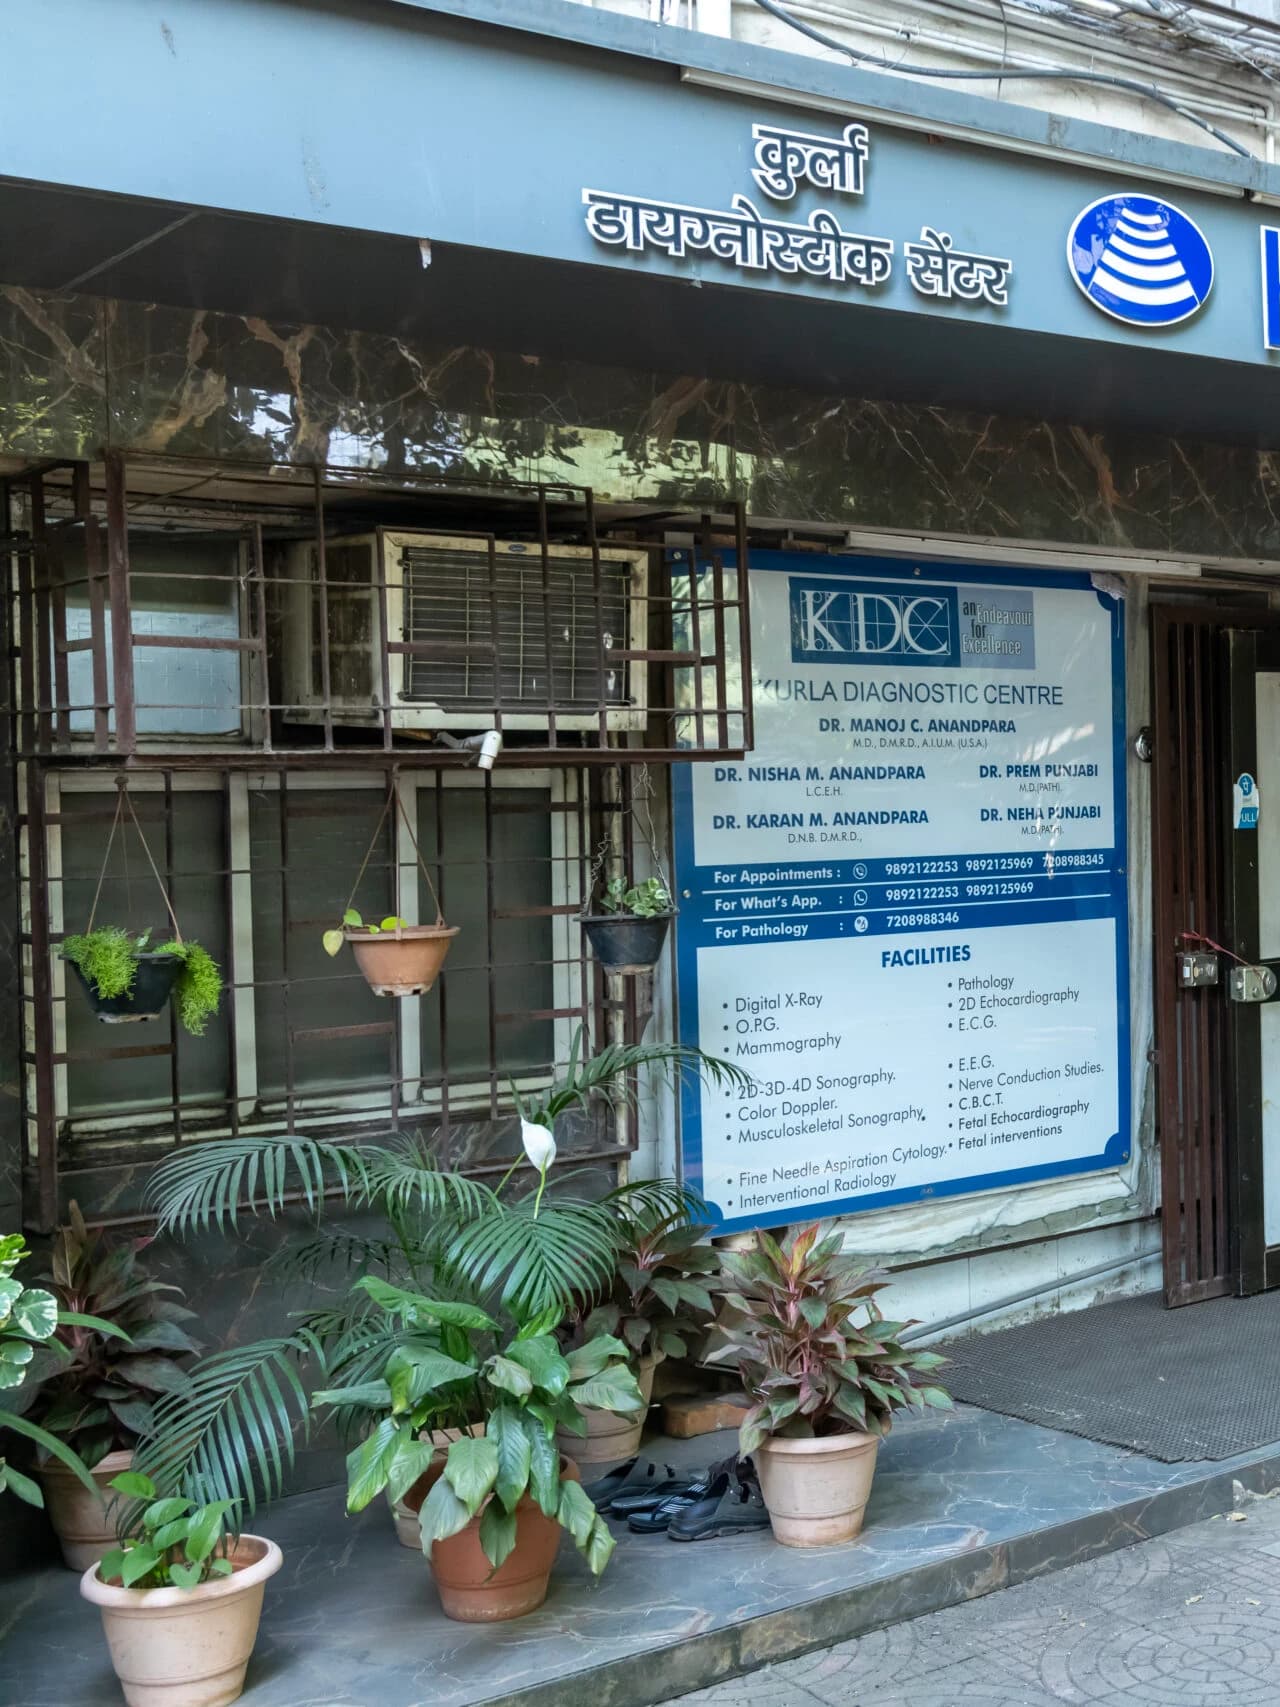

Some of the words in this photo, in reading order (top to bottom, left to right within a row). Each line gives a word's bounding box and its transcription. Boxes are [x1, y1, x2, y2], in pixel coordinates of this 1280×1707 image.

[752, 123, 868, 200] कुर्ला
[581, 188, 894, 286] डायग्नोस्टीक
[904, 226, 1012, 305] सेंटर
[803, 590, 948, 655] KDC
[963, 601, 977, 616] an
[977, 604, 1033, 626] Endeavour
[971, 620, 986, 639] for
[962, 634, 1022, 655] Excellence
[843, 681, 978, 704] DIAGNOSTIC
[983, 684, 1064, 705] CENTRE
[819, 718, 845, 733] DR.
[850, 718, 906, 733] MANOJ
[910, 719, 924, 733] C.
[928, 719, 1016, 733] ANANDPARA
[853, 738, 877, 749] M.D.,
[879, 738, 919, 749] D.M.R.D.,
[714, 767, 742, 782] DR.
[748, 767, 800, 782] NISHA
[806, 767, 824, 781] M.
[829, 766, 925, 780] ANANDPARA
[980, 765, 1002, 778] DR.
[1006, 764, 1041, 778] PREM
[1045, 763, 1098, 777] PUNJABI
[806, 786, 843, 797] L.C.E.H.
[713, 815, 741, 829] DR.
[746, 813, 804, 829] KARAN
[809, 812, 828, 827] M.
[833, 810, 929, 826] ANANDPARA
[980, 808, 1003, 822] DR.
[1007, 807, 1044, 821] NEHA
[1048, 806, 1101, 819] PUNJABI
[788, 833, 817, 843] D.N.B.
[820, 831, 863, 842] D.M.R.D.,
[1021, 825, 1064, 835] M.D(PATH).
[714, 871, 736, 883] For
[740, 868, 833, 885] Appointments
[885, 861, 958, 875] 9892122253
[966, 857, 1033, 871] 9892125969
[715, 899, 737, 911] For
[791, 895, 822, 909] App.
[886, 886, 959, 901] 9892122253
[966, 882, 1034, 897] 9892125969
[715, 927, 738, 939] For
[742, 923, 809, 937] Pathology
[886, 912, 959, 927] 7208988346
[881, 944, 972, 968] FACILITIES
[958, 975, 1014, 991] Pathology
[736, 994, 780, 1014] Digital
[785, 992, 823, 1009] X-Ray
[959, 996, 976, 1011] 2D
[980, 986, 1079, 1008] Echocardiography
[736, 1017, 780, 1034] O.P.G.
[959, 1015, 997, 1031] E.C.G.
[736, 1032, 842, 1056] Mammography
[959, 1055, 995, 1072] E.E.G.
[738, 1077, 812, 1100] 2D-3D-4D
[816, 1068, 896, 1091] Sonography.
[959, 1078, 993, 1092] Nerve
[997, 1067, 1061, 1087] Conduction
[1064, 1061, 1105, 1077] Studies.
[738, 1105, 776, 1122] Color
[782, 1097, 838, 1118] Doppler.
[958, 1092, 1004, 1111] C.B.C.T.
[959, 1114, 987, 1131] Fetal
[991, 1100, 1090, 1126] Echocardiography
[738, 1114, 843, 1144] Musculoskeletal
[959, 1134, 987, 1150] Fetal
[991, 1123, 1063, 1146] interventions
[739, 1170, 768, 1187] Fine
[772, 1161, 820, 1182] Needle
[823, 1151, 888, 1175] Aspiration
[892, 1143, 948, 1164] Cytology.
[739, 1182, 830, 1209] Interventional
[834, 1172, 897, 1194] Radiology
